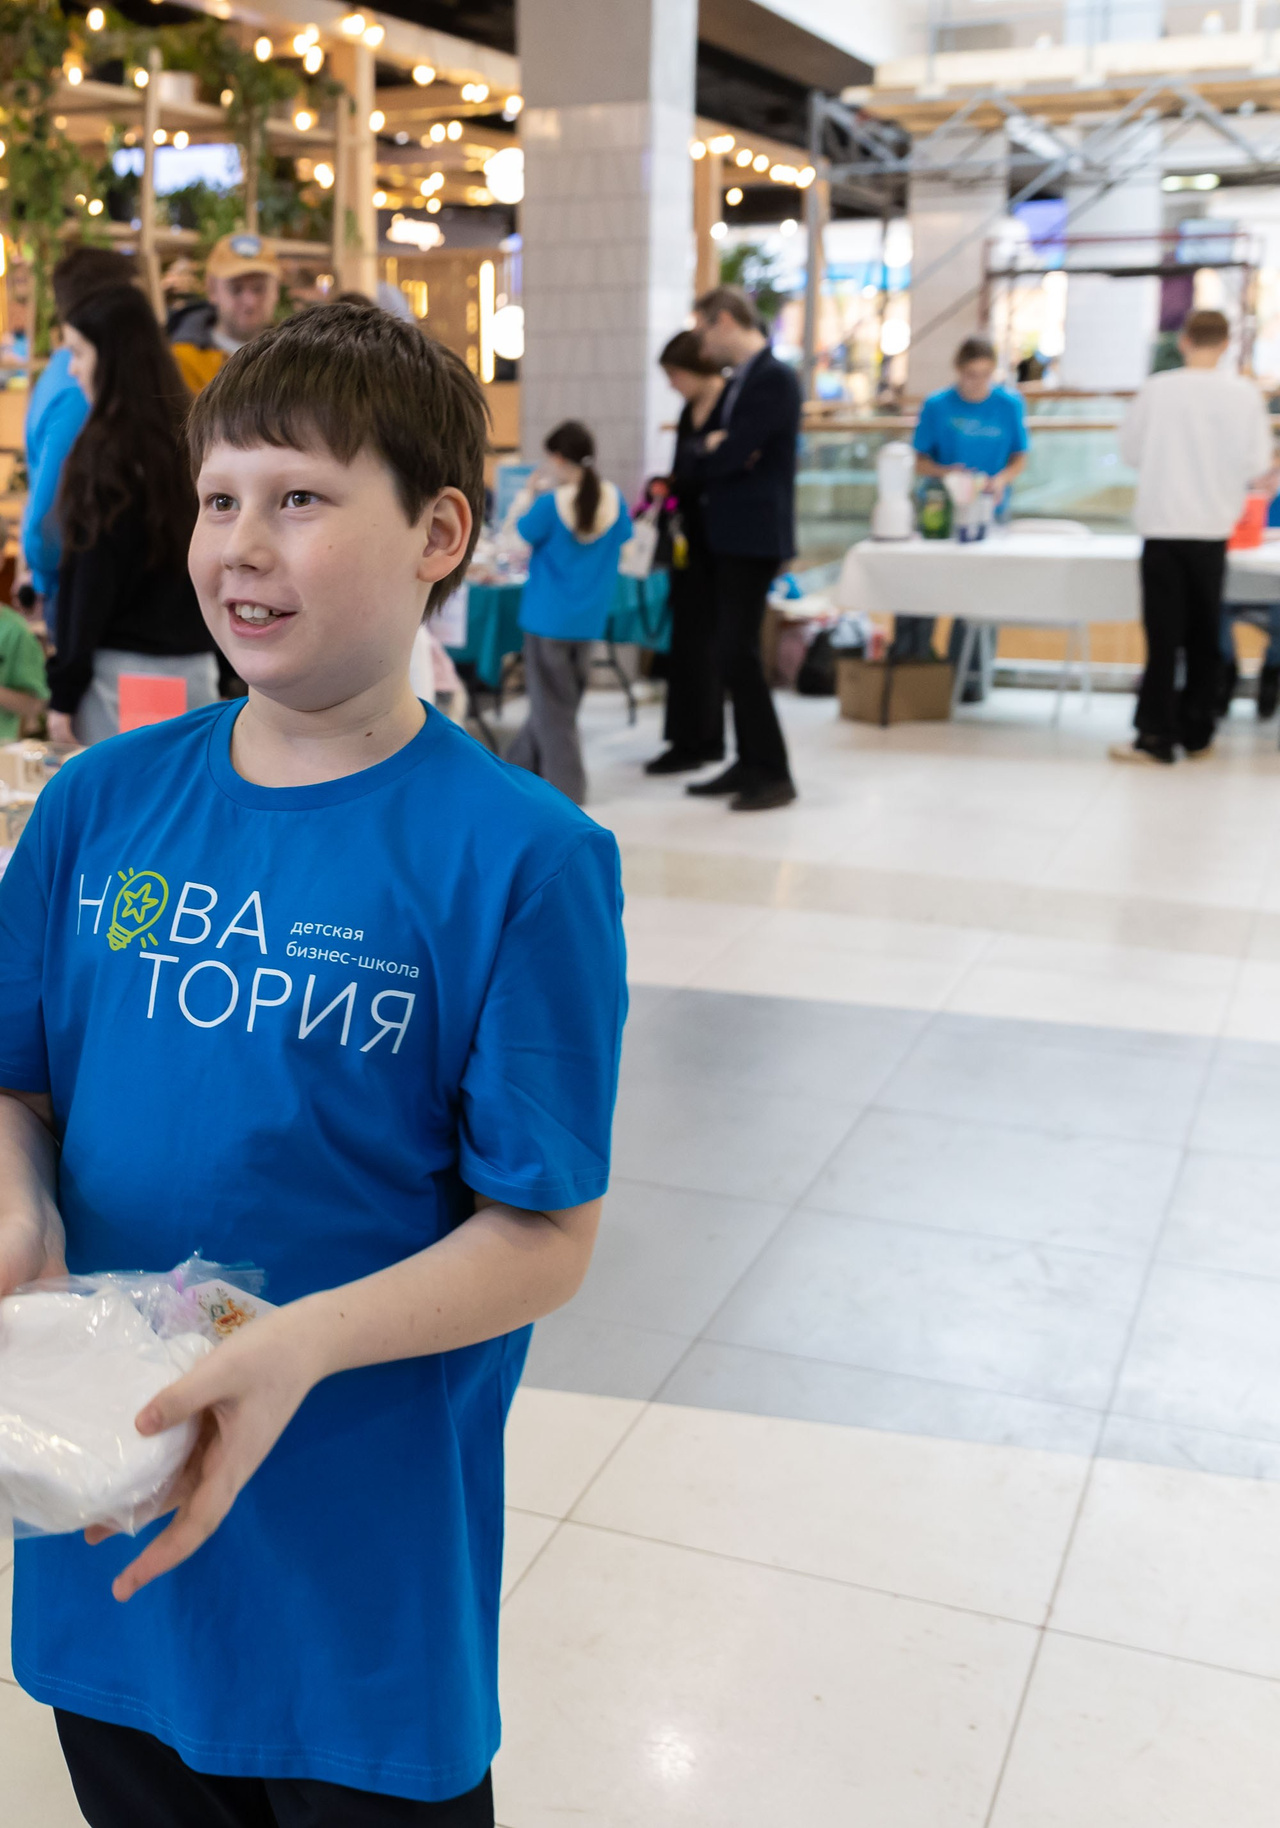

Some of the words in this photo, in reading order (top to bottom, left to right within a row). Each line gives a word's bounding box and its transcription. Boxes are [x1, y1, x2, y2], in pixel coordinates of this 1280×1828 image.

[290, 921, 364, 942] детская
[286, 940, 420, 979] бизнес-школа
[139, 951, 416, 1054] ТОРИЯ
